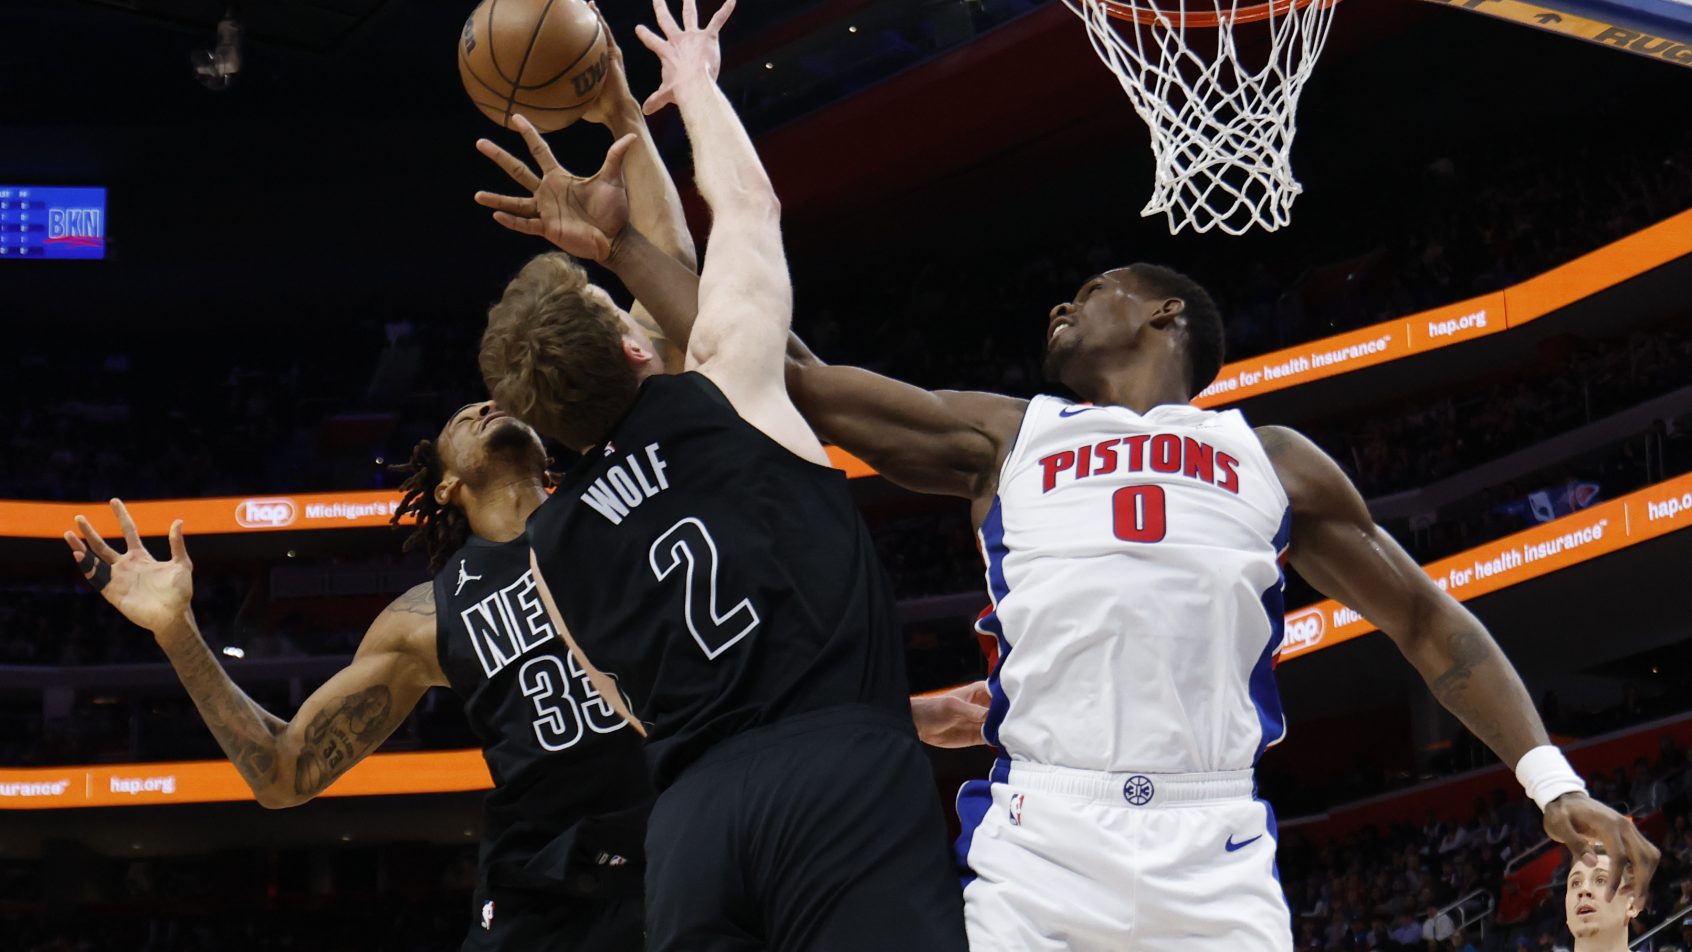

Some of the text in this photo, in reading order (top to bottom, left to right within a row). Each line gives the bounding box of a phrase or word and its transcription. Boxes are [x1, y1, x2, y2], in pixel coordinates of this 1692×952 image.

[48, 208, 100, 239] BKN
[1429, 308, 1487, 338] hap.org
[1239, 370, 1262, 388] for
[1264, 357, 1310, 380] health
[1038, 433, 1240, 494] PISTONS
[580, 441, 671, 526] WOLF
[244, 501, 288, 526] hap
[304, 502, 386, 520] Michigan's
[1111, 483, 1167, 543] 0
[1648, 492, 1692, 522] hap.o
[1450, 568, 1473, 589] for
[1475, 548, 1522, 579] health
[648, 516, 761, 661] 2
[461, 569, 561, 678] NE
[0, 780, 66, 797] urance
[110, 775, 176, 795] hap.org
